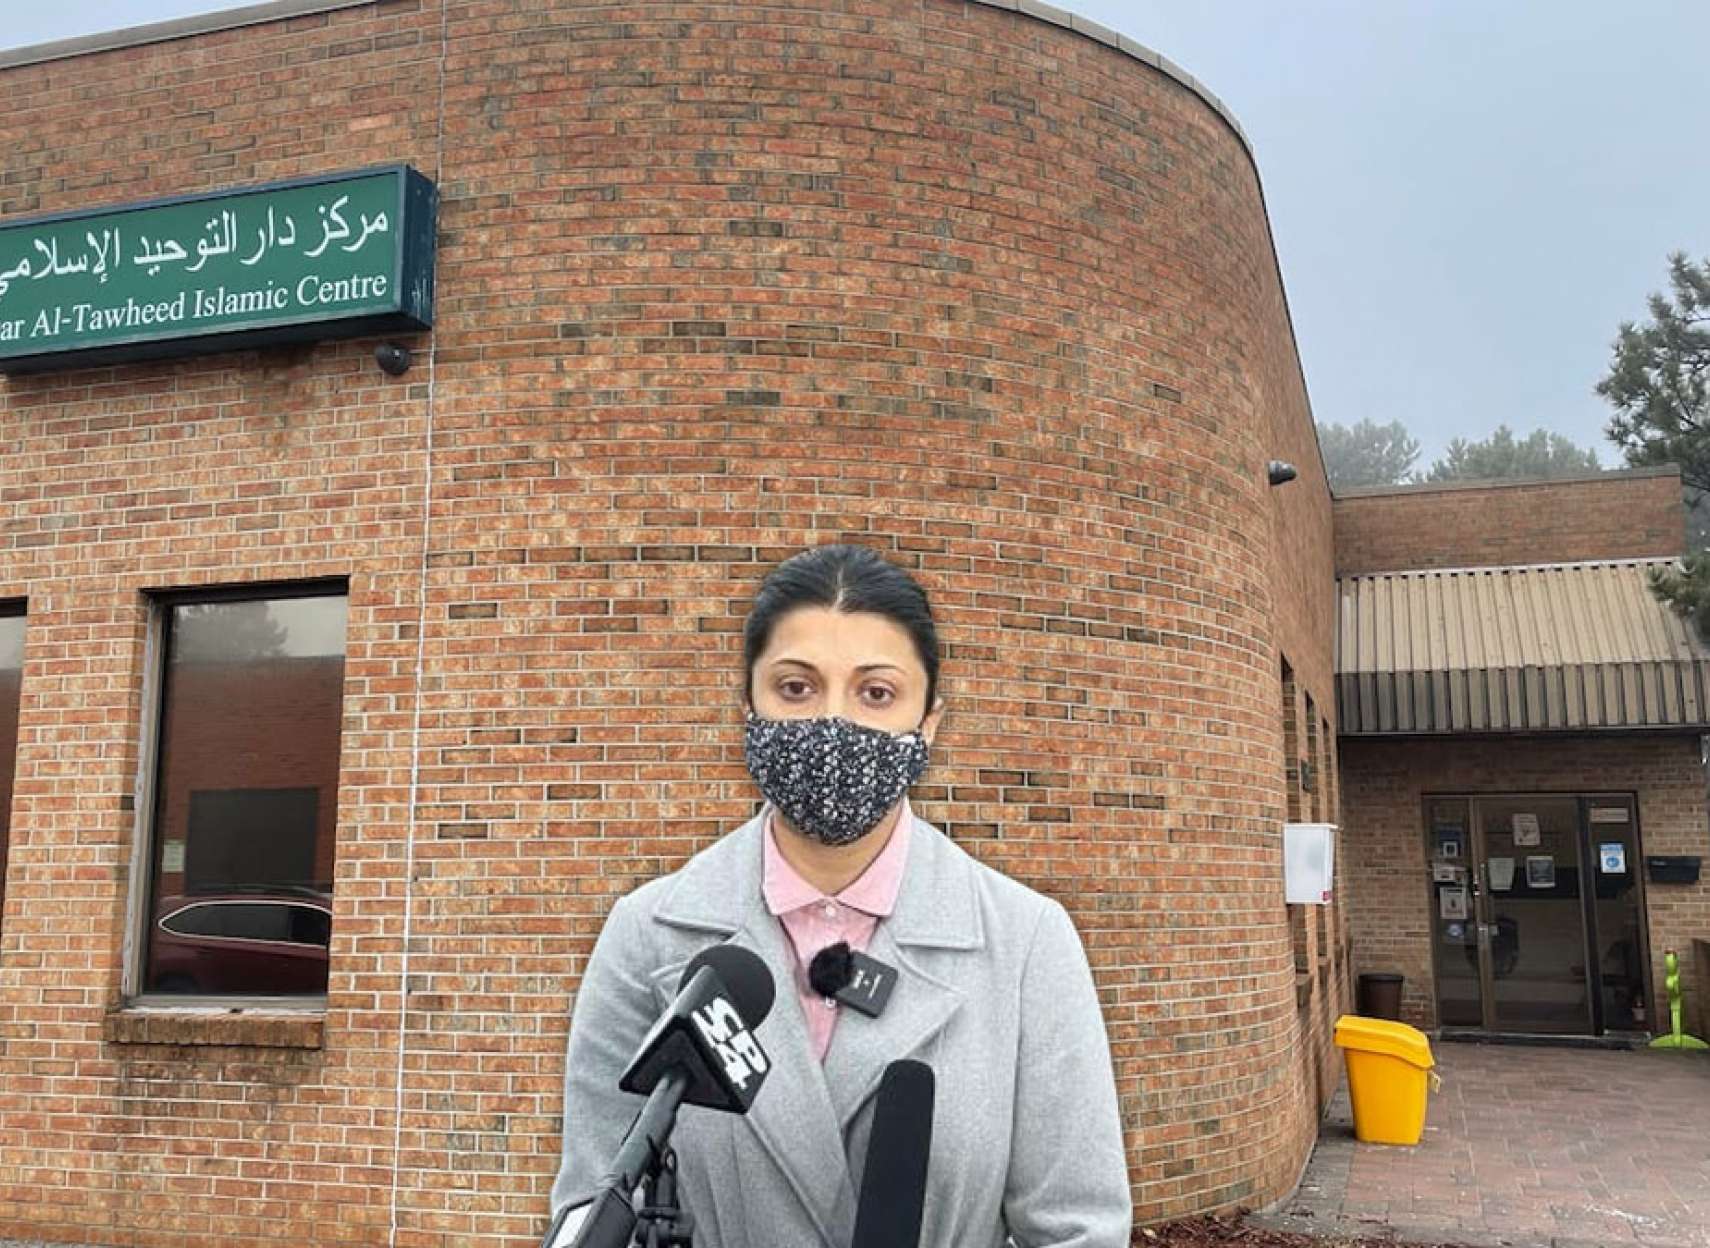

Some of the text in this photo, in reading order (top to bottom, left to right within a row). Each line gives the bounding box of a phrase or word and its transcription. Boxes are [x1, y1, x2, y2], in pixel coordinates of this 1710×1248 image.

[133, 209, 237, 277] التوحيد
[239, 205, 296, 266] دار
[303, 195, 389, 258] مركز
[0, 274, 387, 341] ar Al-Tawheed Islamic Centre
